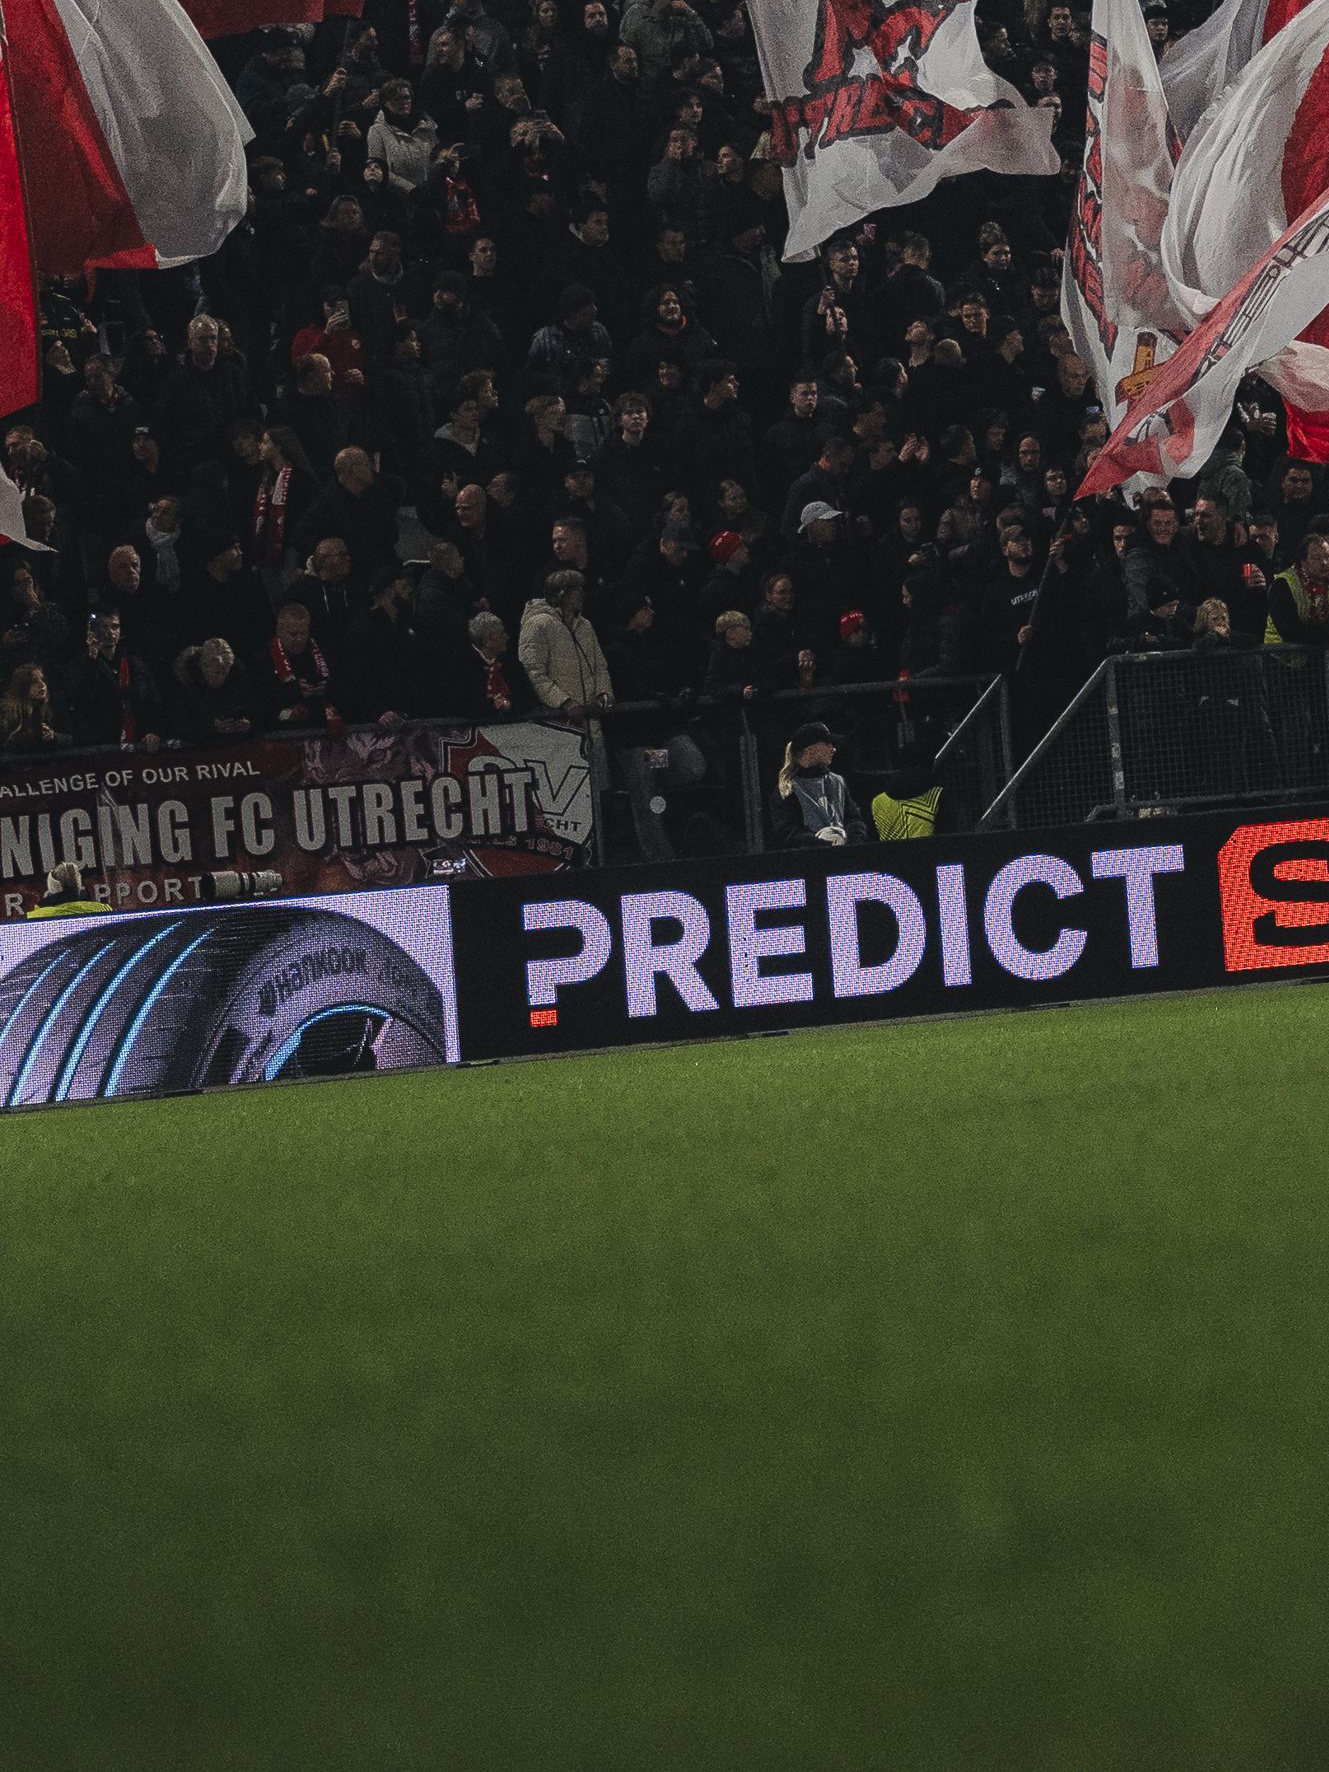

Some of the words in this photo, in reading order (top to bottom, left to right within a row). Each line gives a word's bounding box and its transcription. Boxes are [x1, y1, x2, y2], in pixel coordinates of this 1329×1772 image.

[0, 799, 194, 879] NIGING
[210, 791, 275, 859] FC
[294, 770, 535, 852] UTRECHT
[105, 769, 133, 788] OF
[142, 765, 190, 785] OUR
[198, 760, 261, 780] RIVAL
[523, 844, 1185, 1027] PREDICT
